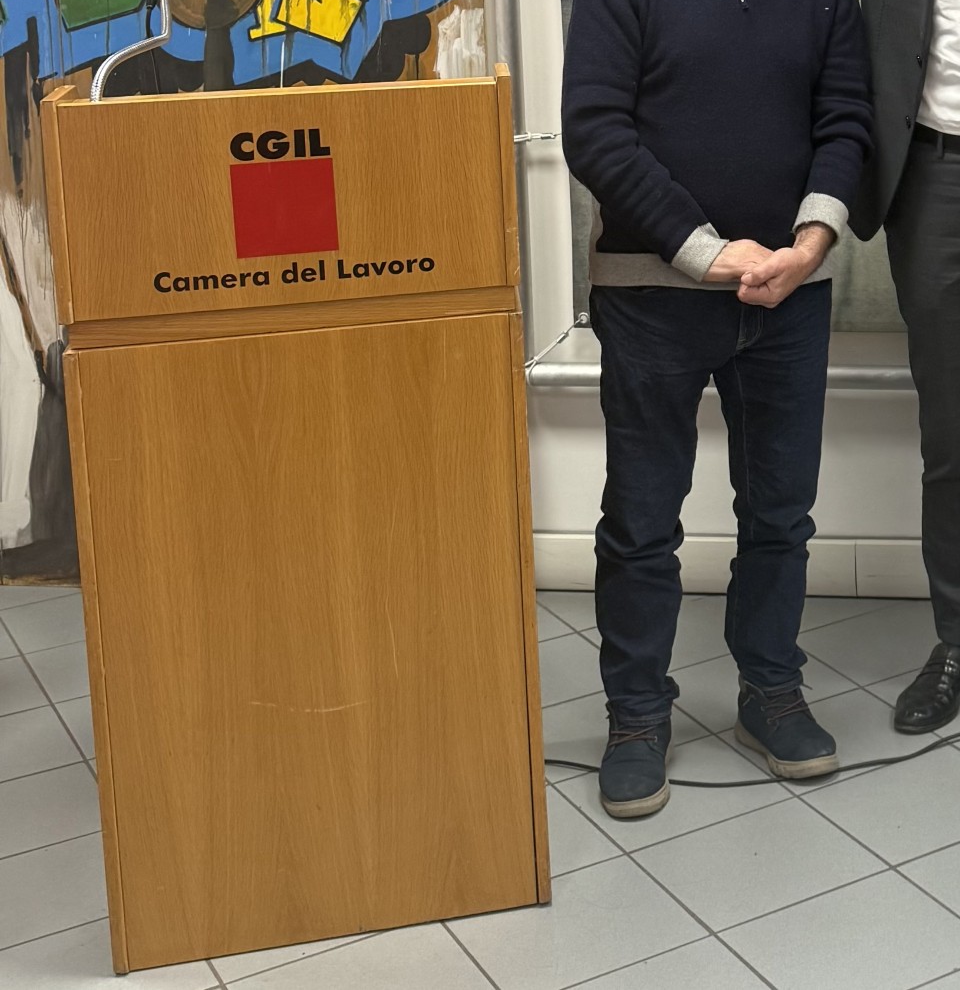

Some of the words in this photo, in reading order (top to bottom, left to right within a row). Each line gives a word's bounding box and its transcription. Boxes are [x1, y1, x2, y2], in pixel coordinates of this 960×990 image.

[229, 128, 331, 162] CGIL
[153, 271, 270, 293] Camera
[281, 259, 326, 284] del
[337, 256, 435, 280] Lavoro
